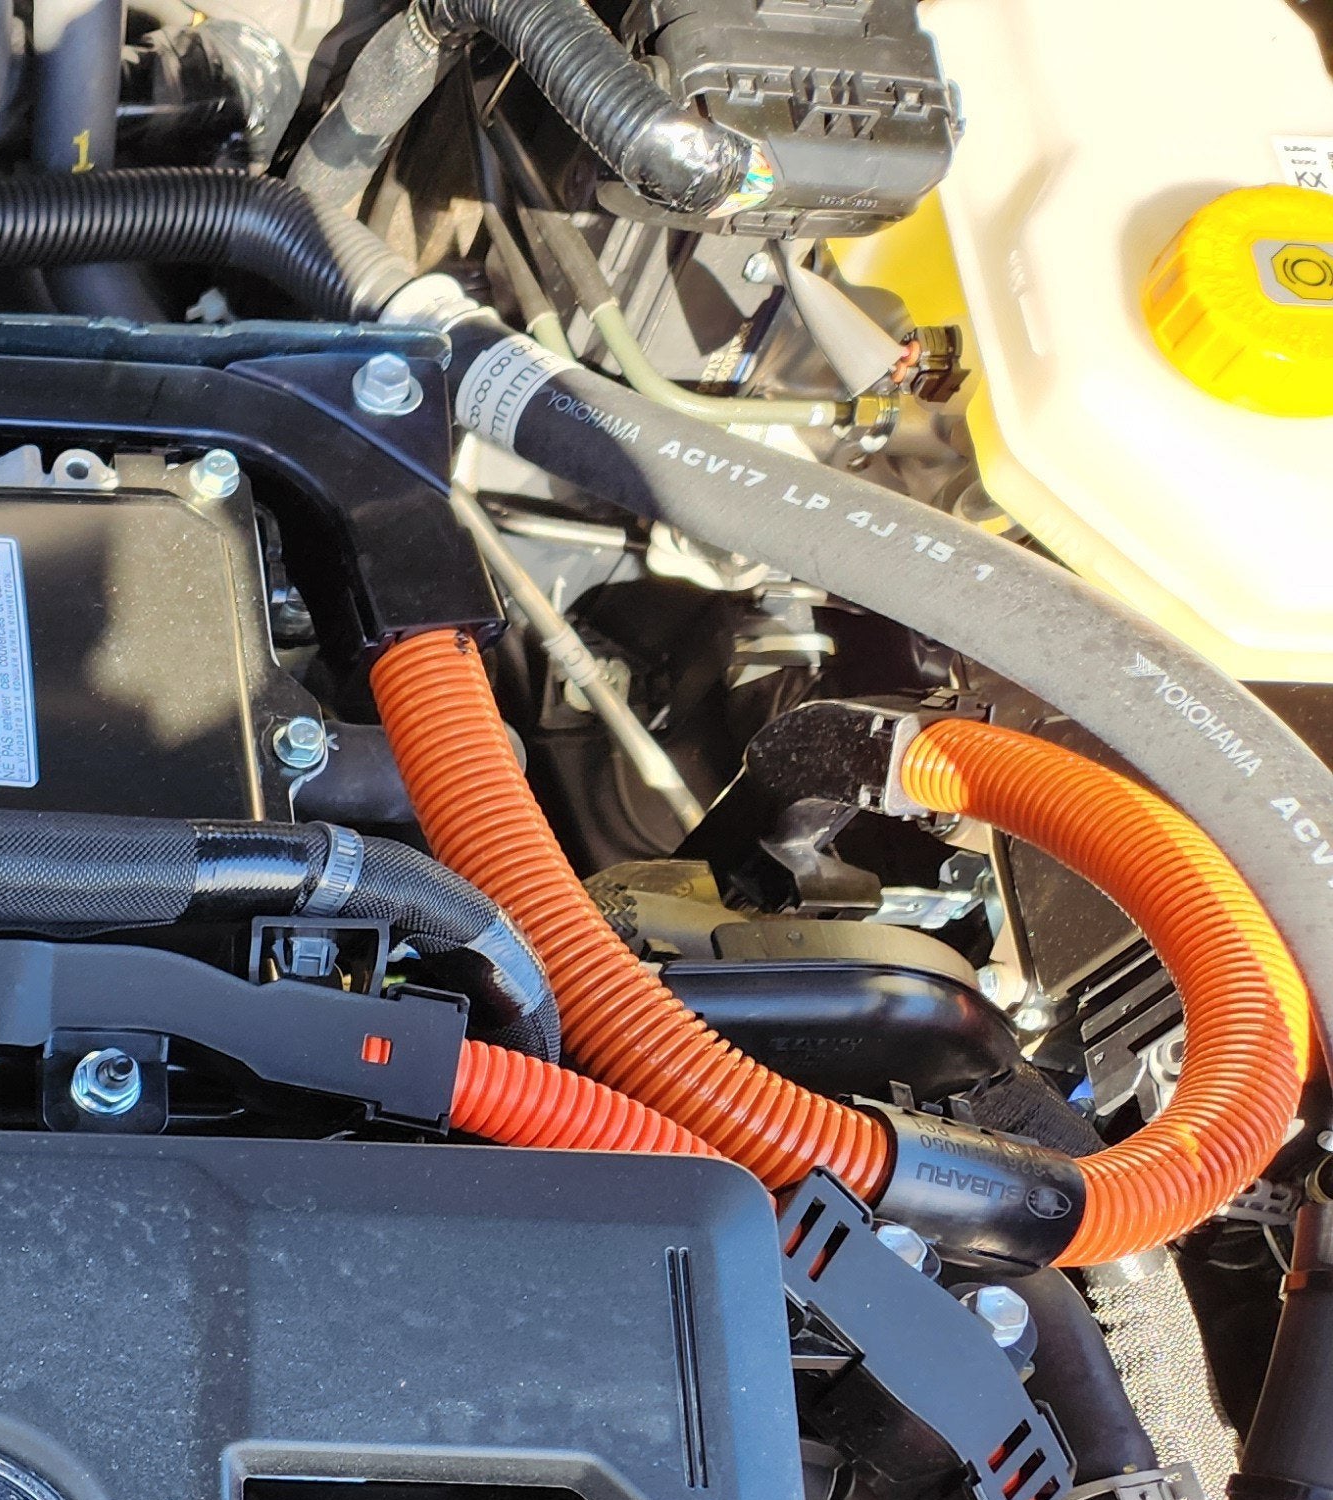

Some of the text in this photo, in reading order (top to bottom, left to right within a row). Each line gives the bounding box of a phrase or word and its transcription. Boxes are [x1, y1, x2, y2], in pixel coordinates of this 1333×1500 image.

[72, 130, 95, 174] 1
[545, 390, 995, 582] YOKOHAMA ACV17 LP 4J 15 1
[0, 695, 12, 731] enlever
[0, 736, 13, 757] PAS
[1154, 674, 1333, 889] YOKOHAMA ACV
[916, 1162, 1026, 1201] SUBARU
